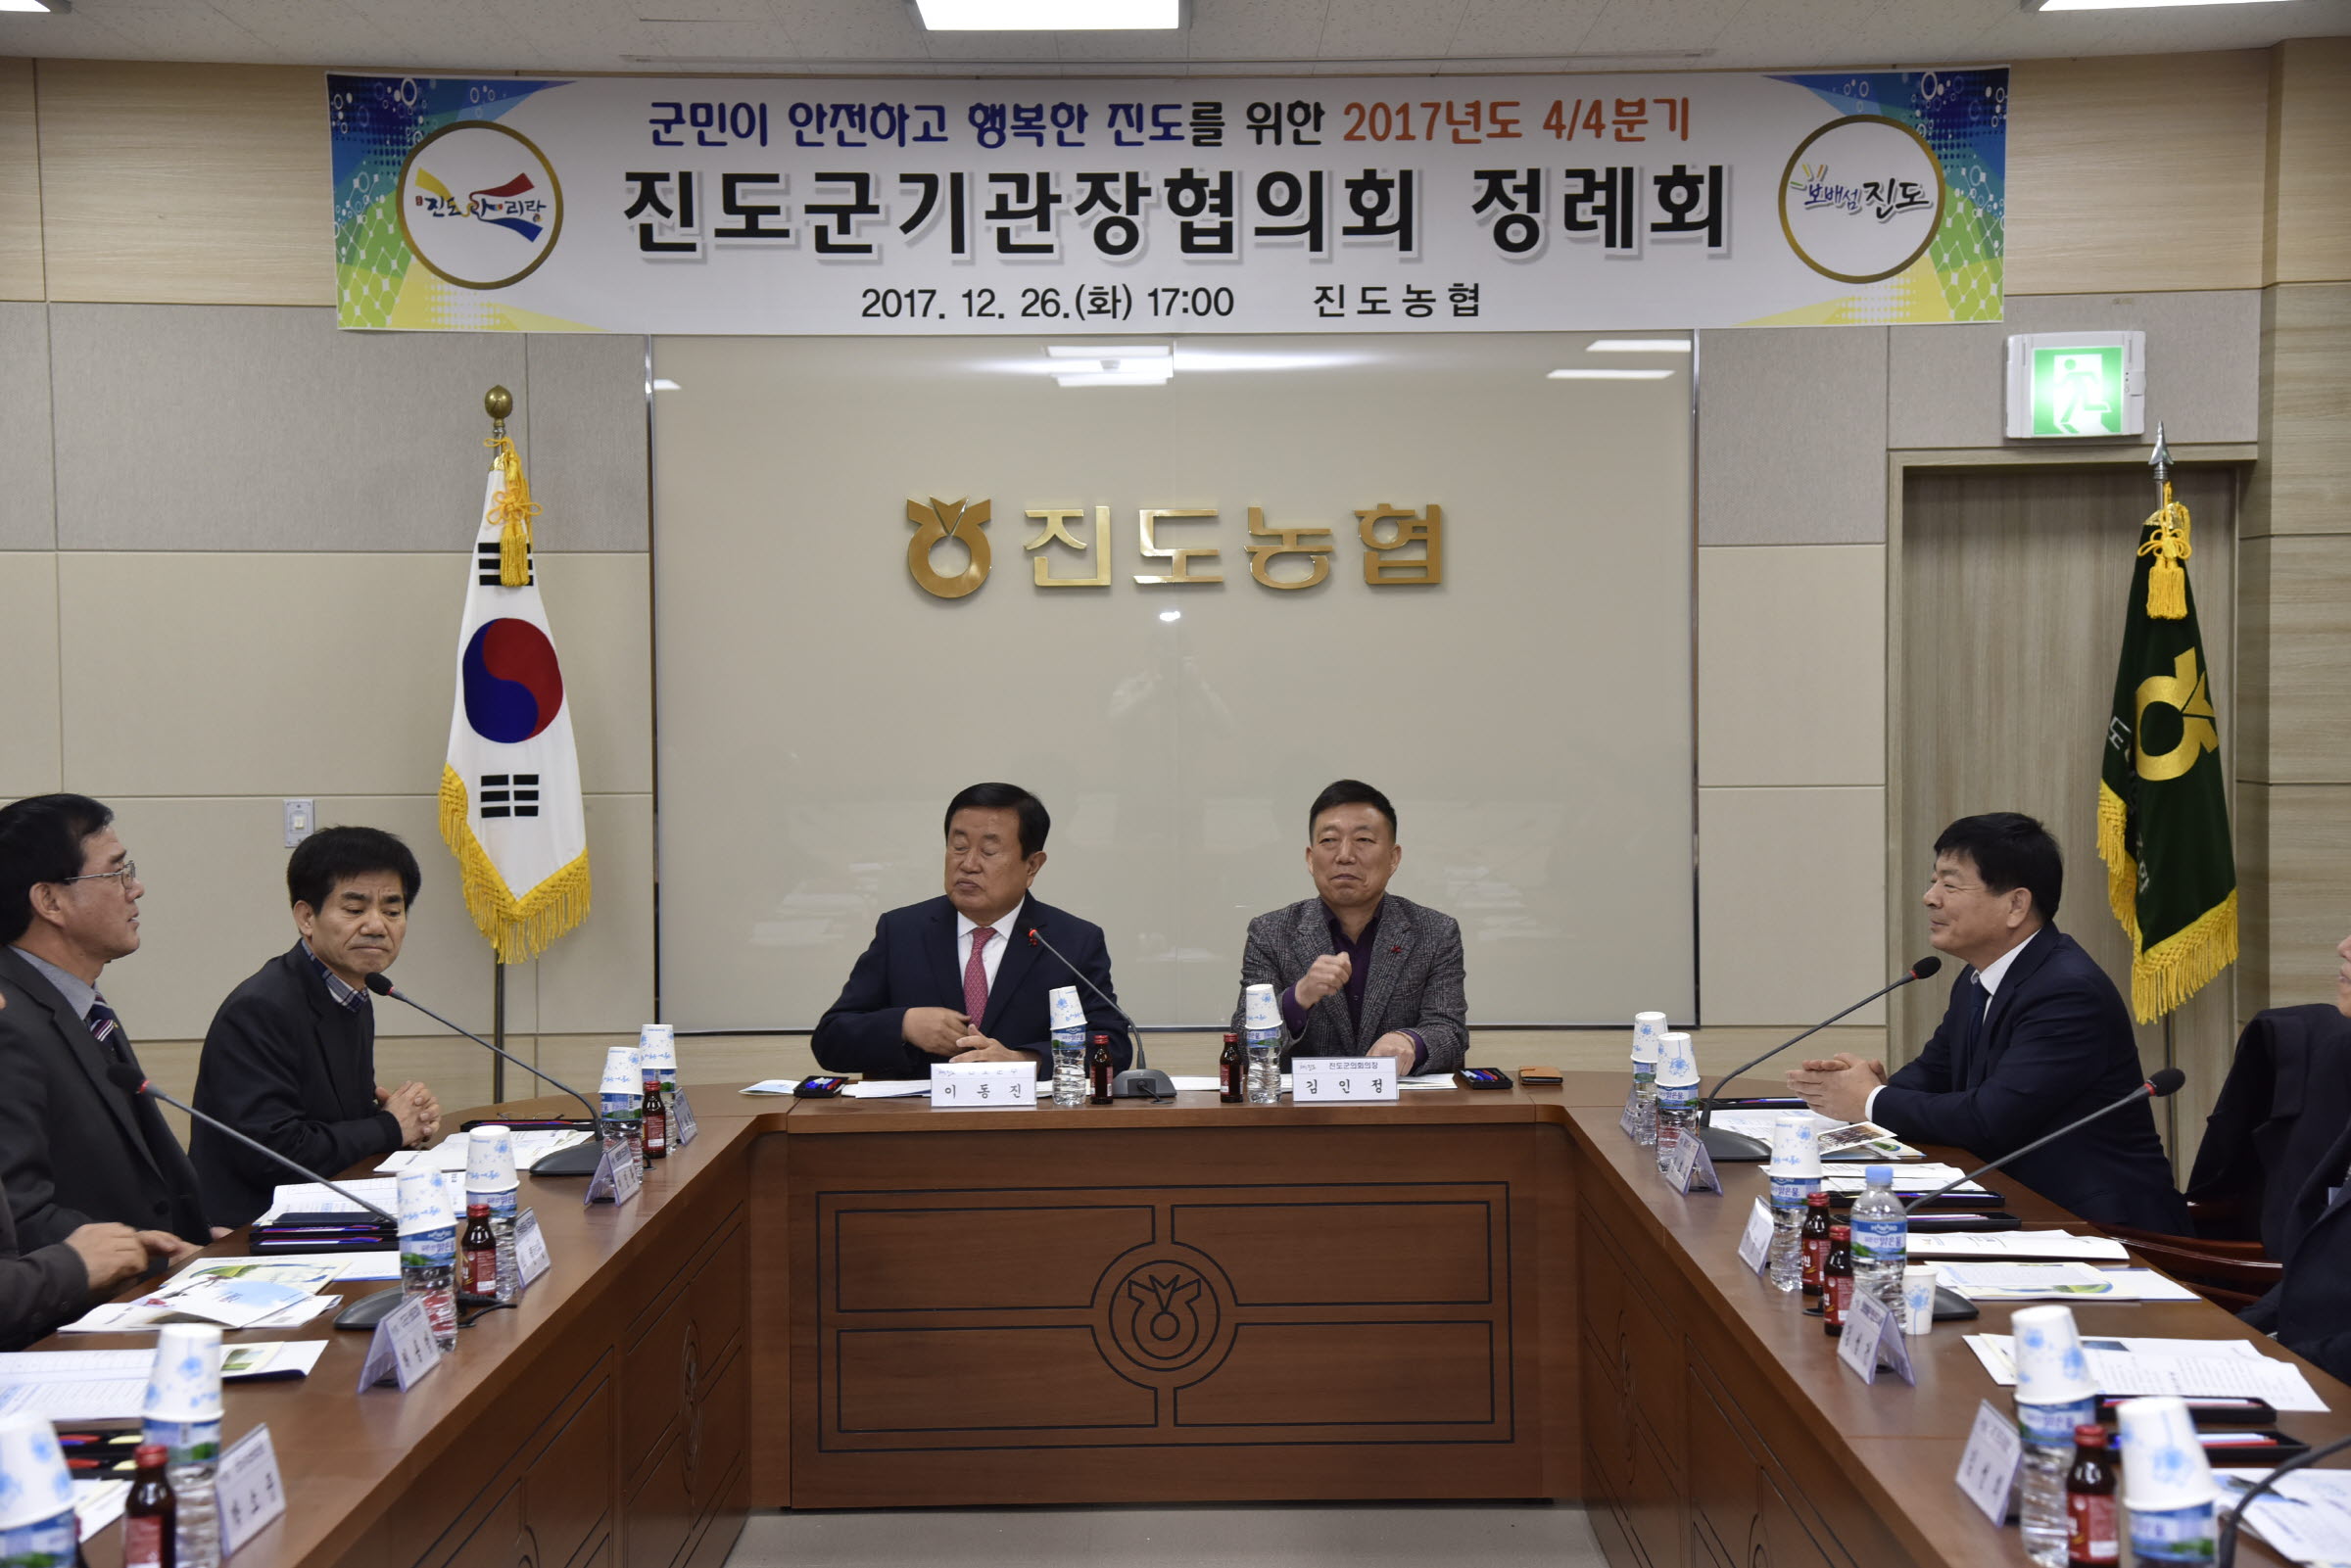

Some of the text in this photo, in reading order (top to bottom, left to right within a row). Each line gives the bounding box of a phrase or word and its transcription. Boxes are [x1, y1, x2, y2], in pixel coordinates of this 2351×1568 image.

[648, 97, 1690, 150] 군민이 안전하고 행복한 진도를 위한 2017년도 4/4분기
[623, 164, 1724, 257] 진도군기관장협의회 정례회
[861, 288, 946, 319] 2017.
[962, 288, 1006, 319] 12.
[1147, 286, 1235, 318] 17:00
[1313, 283, 1480, 318] 진도농협
[1022, 502, 1443, 590] 진도농협
